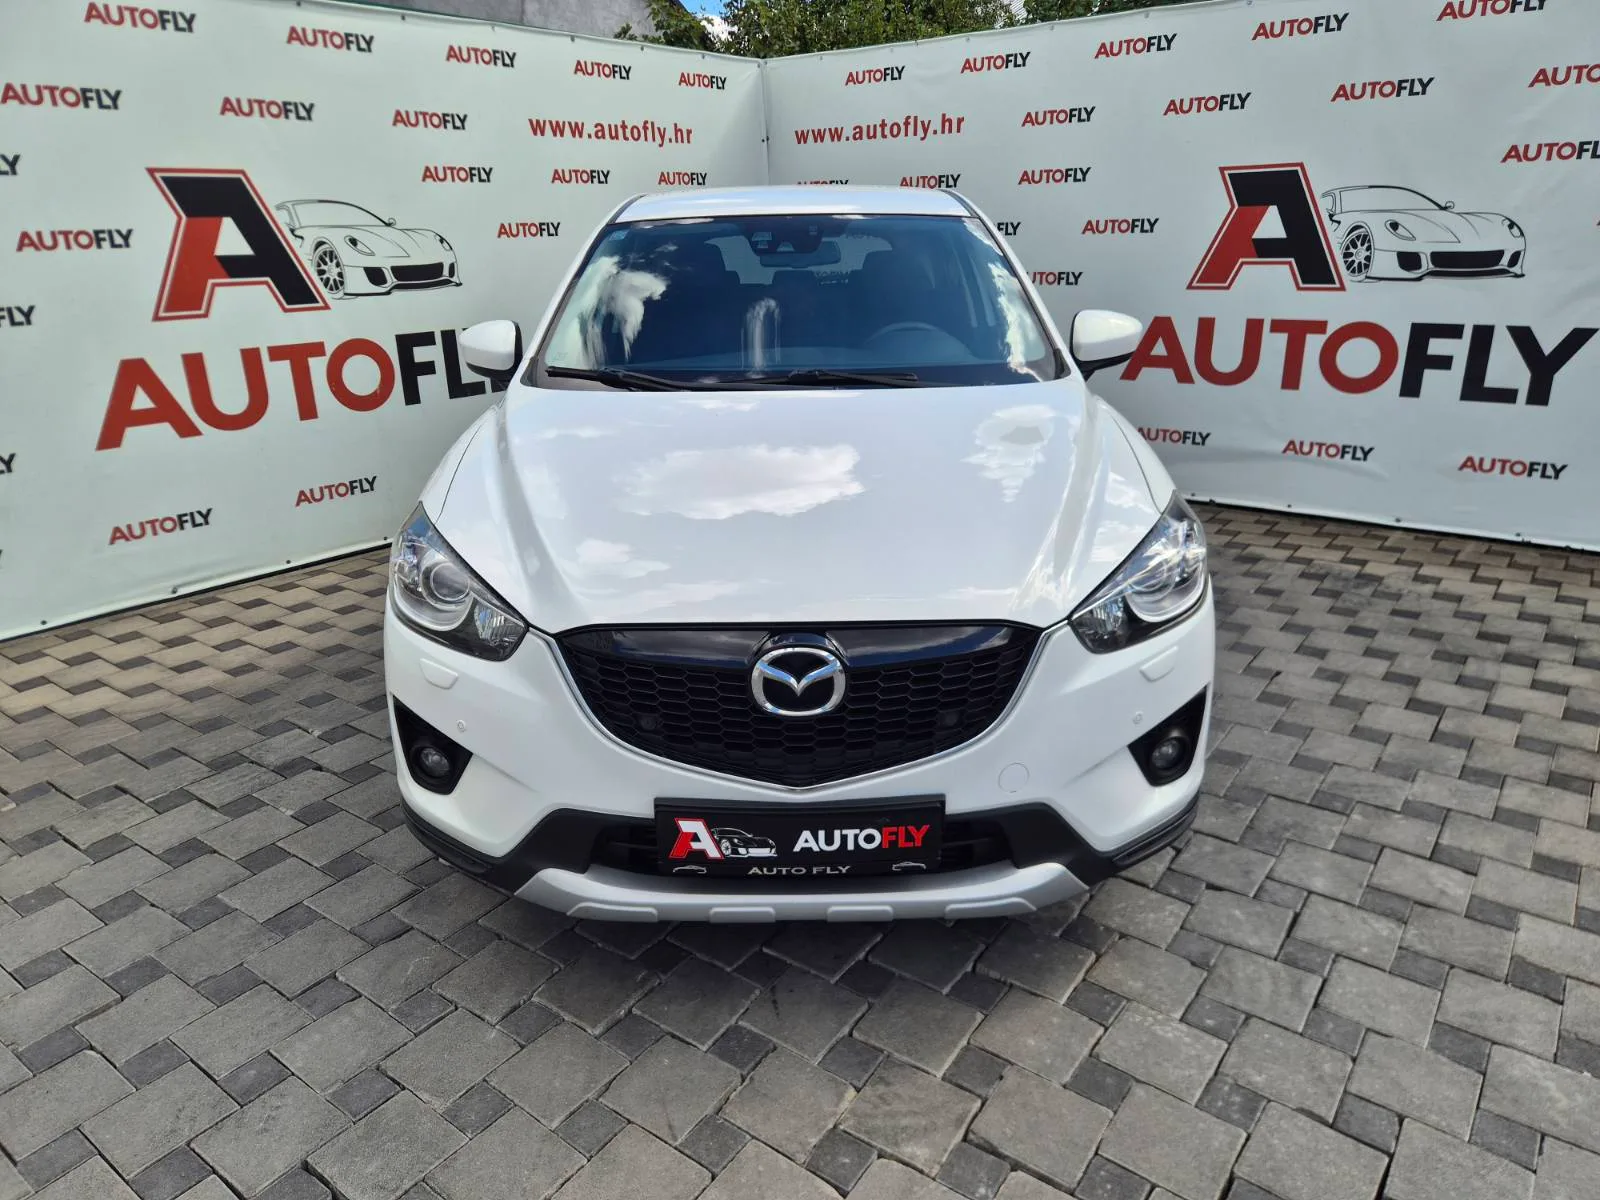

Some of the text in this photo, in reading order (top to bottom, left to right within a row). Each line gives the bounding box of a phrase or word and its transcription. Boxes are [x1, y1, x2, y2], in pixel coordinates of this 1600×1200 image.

[84, 2, 196, 33] AUTOFLY
[1252, 12, 1349, 40] AUTOFLY
[286, 26, 374, 53] AUTOFLY
[1095, 33, 1177, 59] AUTOFLY
[446, 45, 516, 68] AUTOFLY
[960, 52, 1031, 74] AUTOFLY
[574, 60, 631, 80] AUTOFLY
[678, 72, 727, 90] AUTOFLY
[845, 65, 905, 86] AUTOFLY
[0, 83, 122, 110] AUTOFLY
[1331, 77, 1435, 102] AUTOFLY
[220, 97, 314, 121] AUTOFLY
[1163, 92, 1251, 116] AUTOFLY
[392, 110, 467, 130] AUTOFLY
[1021, 106, 1096, 127] AUTOFLY
[528, 117, 693, 147] www.autofly.hr
[795, 113, 964, 144] www.autofly.hr
[1501, 140, 1600, 163] AUTOFL
[422, 166, 493, 183] AUTOFLY
[551, 169, 610, 184] AUTOFLY
[658, 172, 707, 185] AUTOFLY
[1018, 167, 1091, 185] AUTOFLY
[497, 222, 560, 238] AUTOFLY
[1082, 218, 1159, 234] AUTOFLY
[16, 229, 133, 252] AUTOFLY
[1120, 316, 1600, 407] AUTOFLY
[95, 327, 507, 451] AUTOFL
[1282, 440, 1375, 461] AUTOFLY
[1458, 456, 1568, 480] AUTOFLY
[296, 476, 377, 507] AUTOFLY
[109, 508, 212, 545] AUTOFLY
[793, 824, 930, 852] AUTOFLY
[748, 865, 851, 875] AUTO FLY
